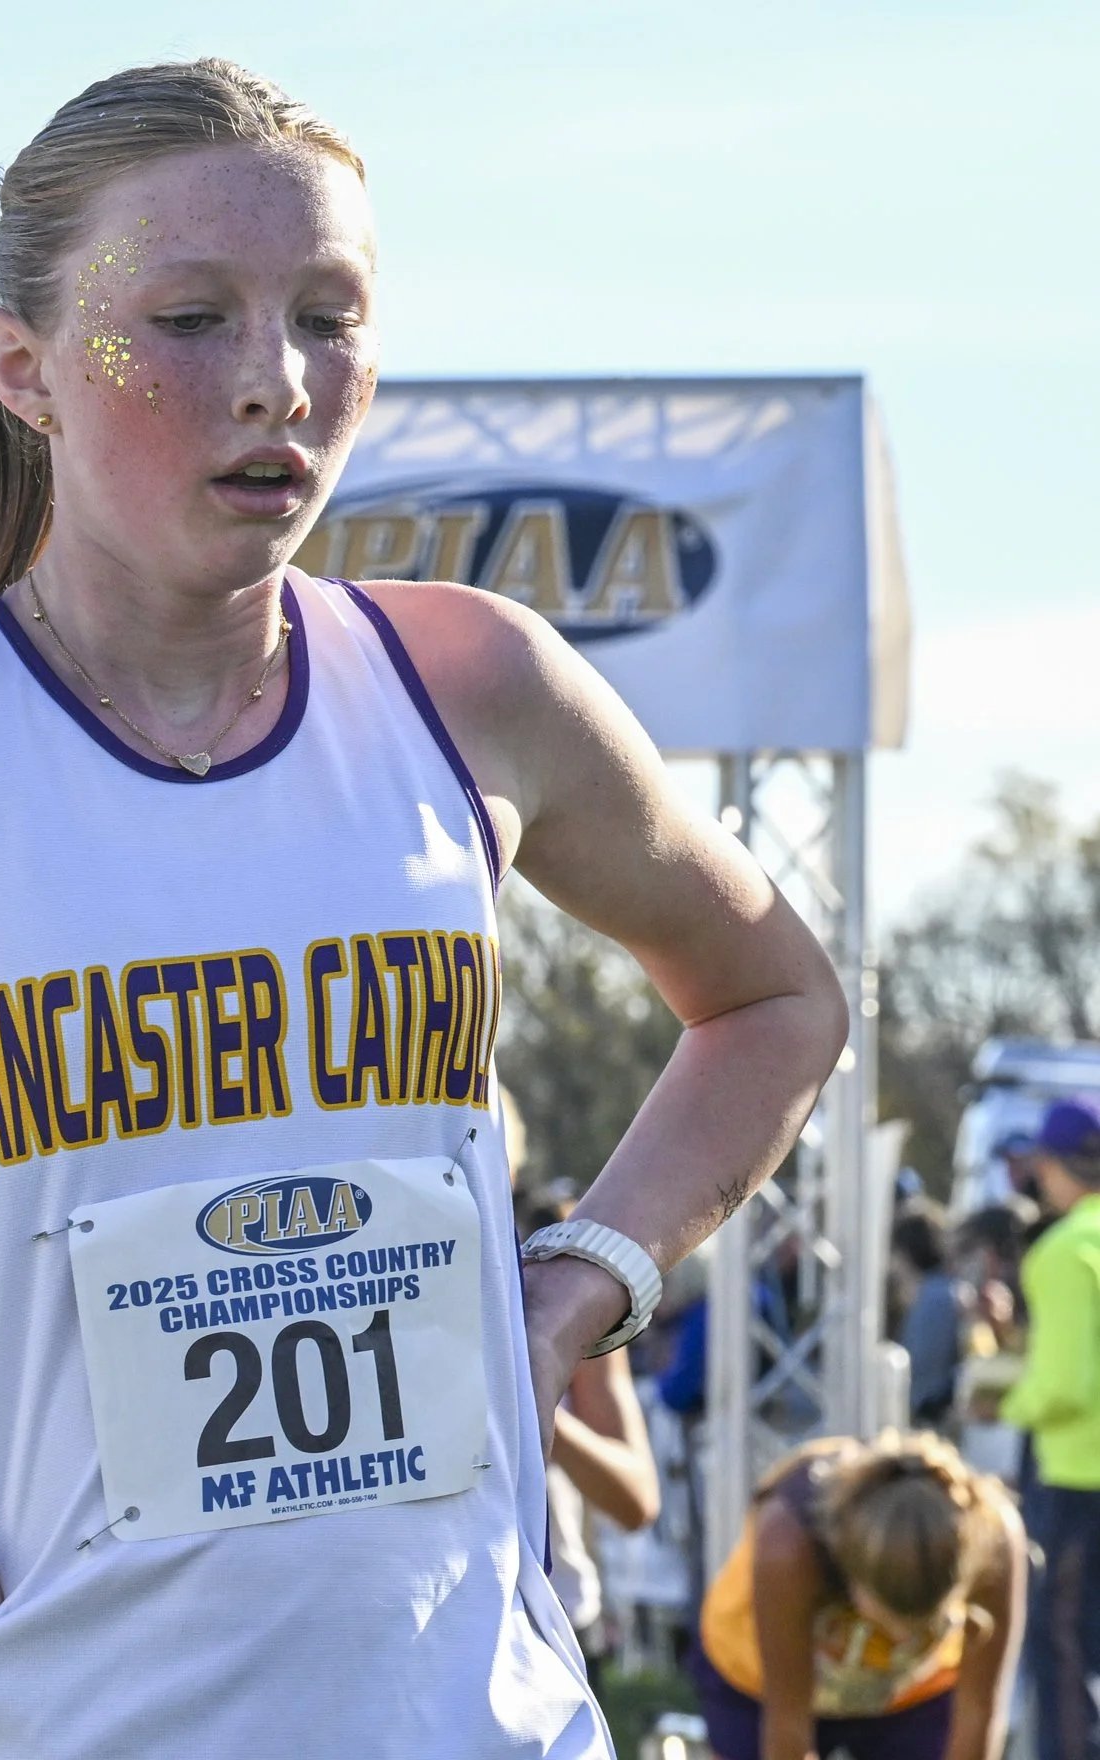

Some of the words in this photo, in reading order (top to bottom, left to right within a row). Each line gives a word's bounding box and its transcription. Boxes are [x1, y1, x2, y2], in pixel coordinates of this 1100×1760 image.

[107, 1274, 199, 1310] 2025
[206, 1257, 318, 1296] CROSS
[325, 1239, 456, 1280] COUNTRY
[159, 1274, 420, 1333] CHAMPIONSHIPS
[184, 1309, 404, 1467] 201
[202, 1470, 256, 1512] MF
[266, 1445, 426, 1503] ATHLETIC
[271, 1500, 333, 1514] MFATHLETIC.COM
